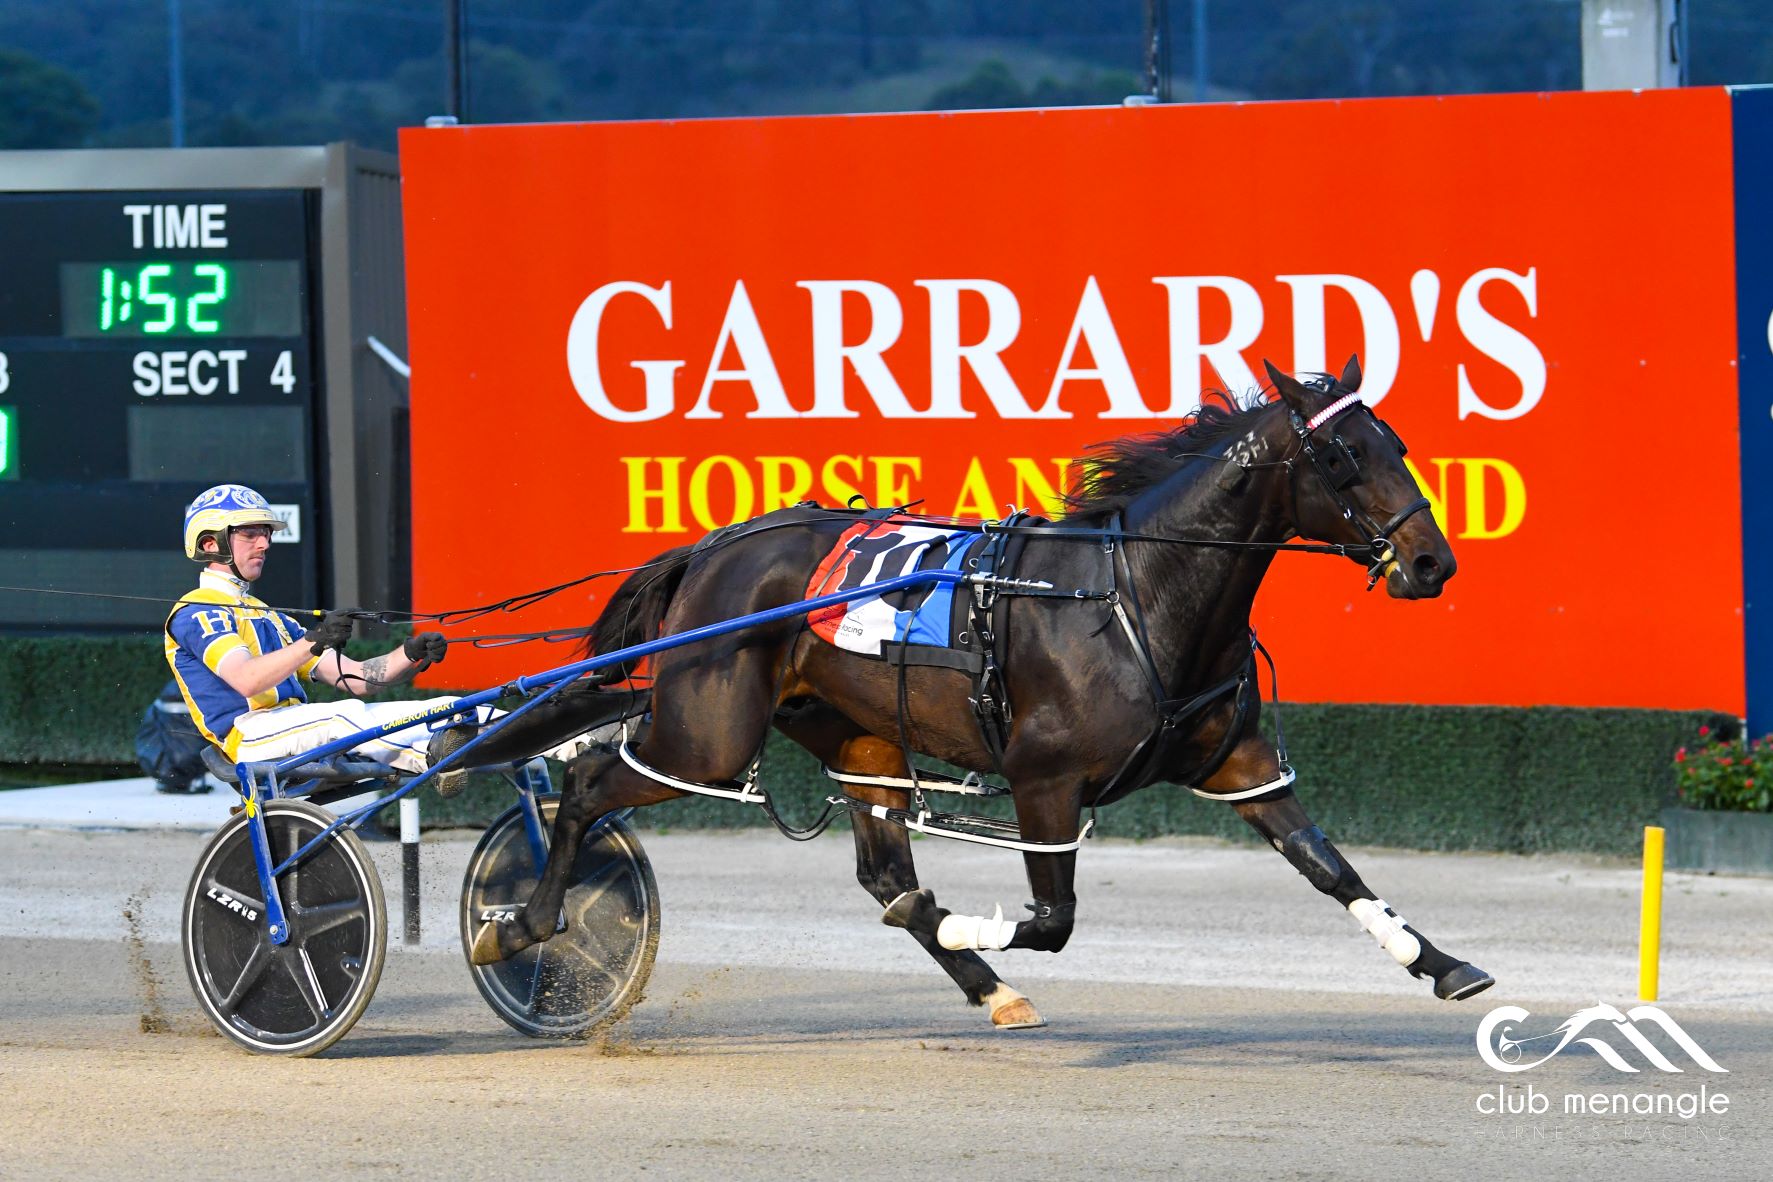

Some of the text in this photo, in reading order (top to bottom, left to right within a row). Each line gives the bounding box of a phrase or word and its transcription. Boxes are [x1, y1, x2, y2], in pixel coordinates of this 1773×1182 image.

[123, 204, 229, 248] TIME
[100, 264, 227, 333] 1:52
[566, 266, 1547, 423] GARRARD'S
[132, 350, 296, 396] SECT 4
[620, 455, 922, 533] HORSE
[191, 609, 233, 639] H
[382, 702, 455, 731] CAMERON HART
[206, 887, 243, 913] LZR
[480, 910, 516, 921] LZR
